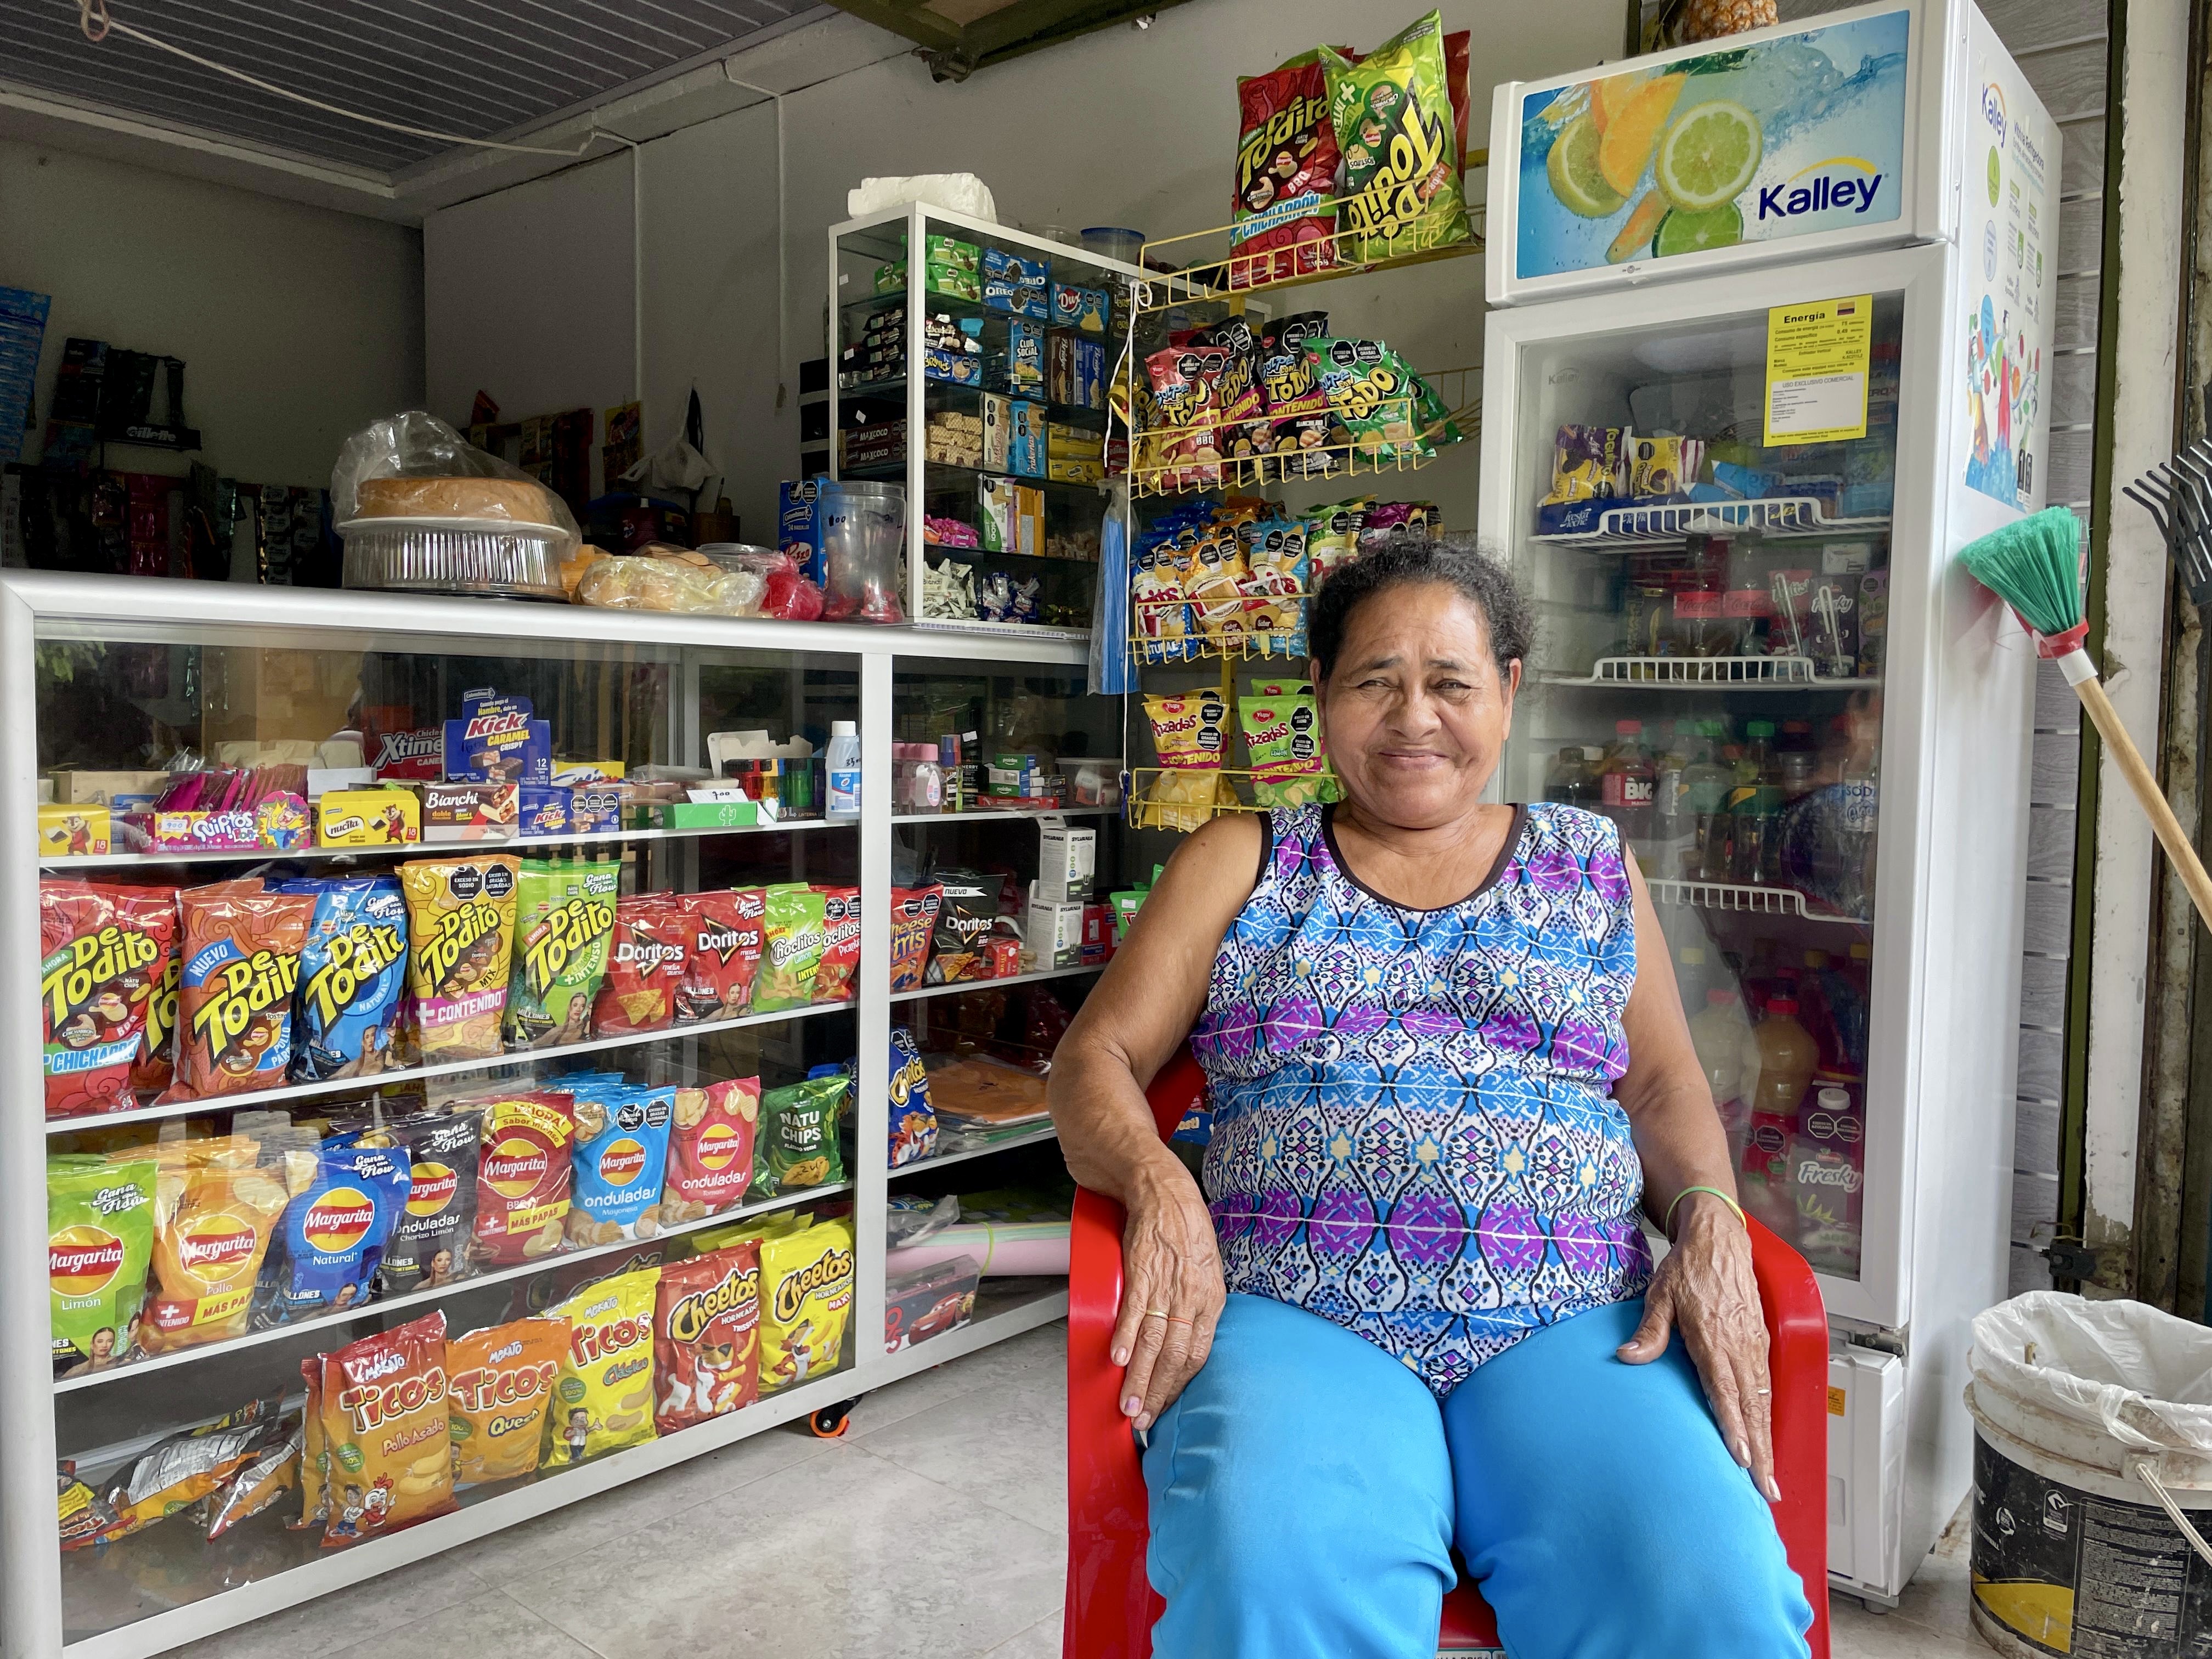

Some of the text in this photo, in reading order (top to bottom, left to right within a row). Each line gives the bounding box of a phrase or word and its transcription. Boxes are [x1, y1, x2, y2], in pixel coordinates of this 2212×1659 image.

[1982, 82, 2006, 148] Kalley
[1759, 174, 1882, 221] Kalley
[985, 287, 1013, 296] OREO
[1784, 312, 1825, 324] Energía
[1017, 346, 1038, 357] SOCIAL
[1020, 339, 1034, 348] CLUB
[860, 428, 888, 441] MAXCOCO
[860, 449, 888, 461] MAXCOCO
[465, 713, 526, 738] Kick
[1151, 715, 1197, 737] Rizadas
[487, 730, 531, 746] CARAMEL
[1243, 723, 1289, 749] Rizadas
[371, 732, 442, 770] Xtime
[500, 741, 523, 752] CRISPY
[537, 758, 547, 767] 12
[426, 791, 479, 809] Bianchi
[1624, 781, 1653, 800] BIG
[534, 810, 565, 823] Kick
[330, 820, 359, 834] nucita
[408, 827, 417, 836] 18
[96, 840, 106, 850] 18
[583, 873, 613, 888] Gana
[589, 882, 618, 896] Flow
[439, 903, 475, 937] De
[548, 900, 584, 937] De
[743, 909, 765, 920] Flow
[946, 916, 993, 932] Doritos
[528, 924, 548, 944] AHORA
[698, 929, 759, 951] Doritos
[70, 927, 119, 969] De
[421, 903, 499, 986] Todito
[526, 900, 613, 994] Todito
[617, 943, 685, 963] Doritos
[770, 932, 821, 966] Choclitos
[893, 930, 926, 961] tris
[41, 952, 69, 974] AHORA
[190, 944, 228, 977] NUEVO
[564, 941, 602, 985] +INTENSO
[793, 951, 812, 964] Limón
[42, 932, 157, 1030] Todito
[223, 951, 272, 995] De
[480, 969, 496, 988] MIX
[359, 981, 388, 1012] NATURAL
[437, 993, 501, 1023] CONTENIDO
[517, 1007, 550, 1020] MILLONES
[503, 1118, 529, 1126] Sabor
[780, 1110, 820, 1127] NATU
[441, 1135, 475, 1153] Flow
[781, 1125, 822, 1144] CHIPS
[698, 1138, 739, 1155] Margarita
[804, 1144, 817, 1152] VERDE
[354, 1154, 385, 1171] Gana
[361, 1163, 394, 1179] Flow
[487, 1159, 546, 1178] Margarita
[601, 1153, 646, 1171] Margarita
[682, 1171, 746, 1189] onduladas
[1801, 1162, 1861, 1192] Fresky
[94, 1183, 136, 1204] Gana
[410, 1178, 456, 1198] argarita
[584, 1187, 657, 1207] onduladas
[703, 1188, 726, 1197] Tomate
[305, 1210, 373, 1231] Margarita
[511, 1207, 559, 1228] MÁS PAPAS
[602, 1206, 638, 1216] Mayonesa
[400, 1227, 454, 1242] Chorizo Limón
[49, 1241, 122, 1270] Margarita
[313, 1254, 356, 1266] Natural
[206, 1284, 233, 1296] Pollo
[777, 1250, 851, 1321] Cheetos
[61, 1299, 101, 1311] Limón
[202, 1301, 229, 1319] MÁS
[671, 1271, 758, 1340] Cheetos
[828, 1294, 850, 1311] MAXI
[568, 1313, 652, 1366] Ticos
[489, 1340, 523, 1364] MEKATO
[603, 1357, 648, 1386] Clásico
[451, 1363, 557, 1412] Ticos
[565, 1387, 583, 1396] 100%
[342, 1369, 445, 1432] Ticos
[489, 1409, 539, 1437] Queso
[382, 1419, 445, 1457] Pollo Asado
